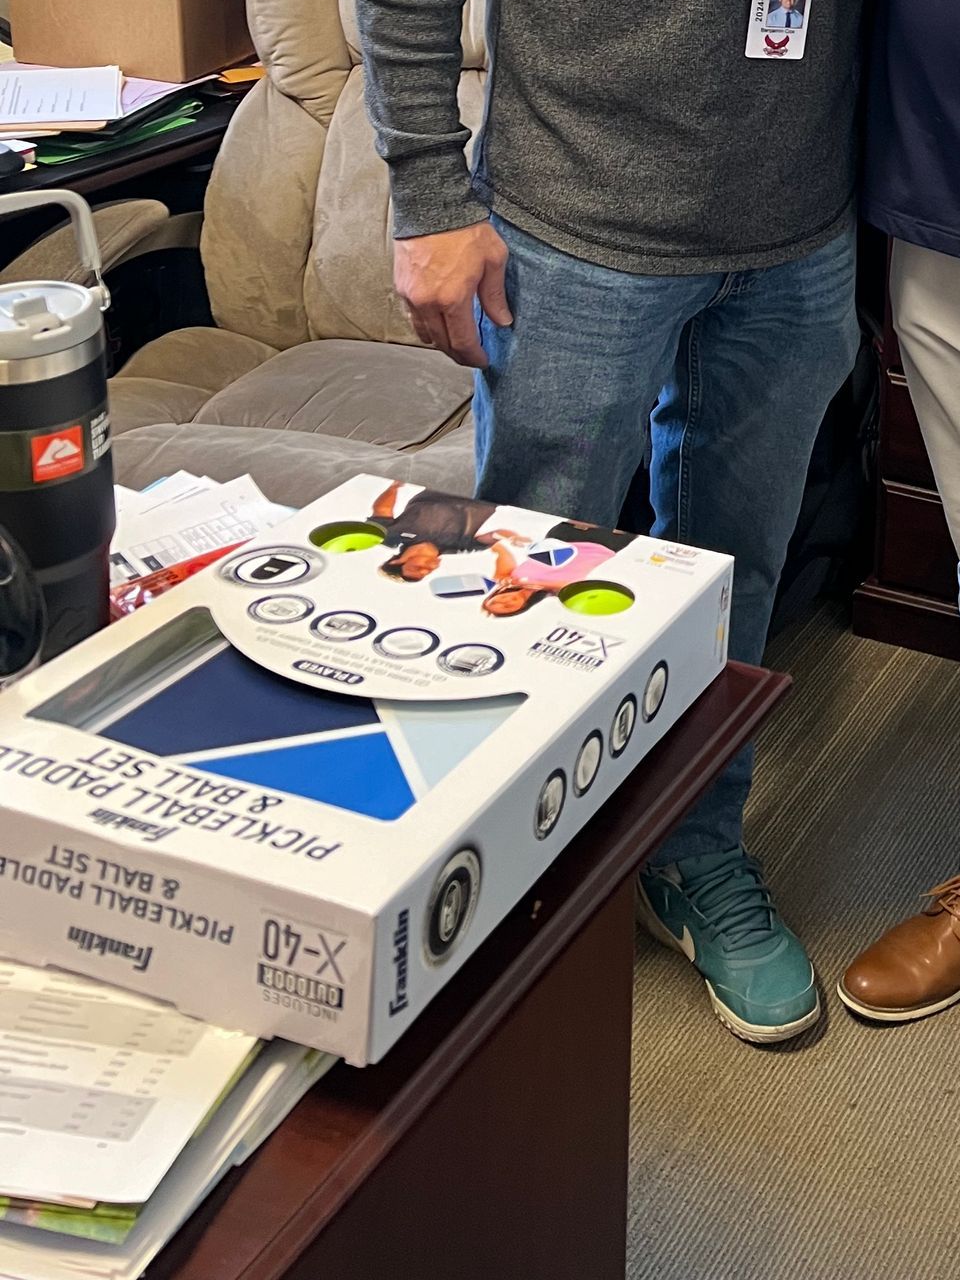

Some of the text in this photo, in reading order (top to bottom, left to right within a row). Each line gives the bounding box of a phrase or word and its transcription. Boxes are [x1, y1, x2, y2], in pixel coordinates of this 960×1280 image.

[546, 626, 626, 660] X-40
[300, 661, 348, 681] PLAYER
[76, 746, 284, 814] & BALL SET
[87, 807, 182, 843] franklin
[118, 785, 344, 861] PICKLEBALL
[45, 844, 180, 900] & BALL SET
[93, 881, 235, 945] PICKLEBALL
[67, 925, 154, 972] franklin
[262, 918, 348, 983] X-40
[389, 908, 410, 1017] franklin
[259, 964, 342, 1008] OUTDOOR
[262, 987, 338, 1023] INCLUDES
